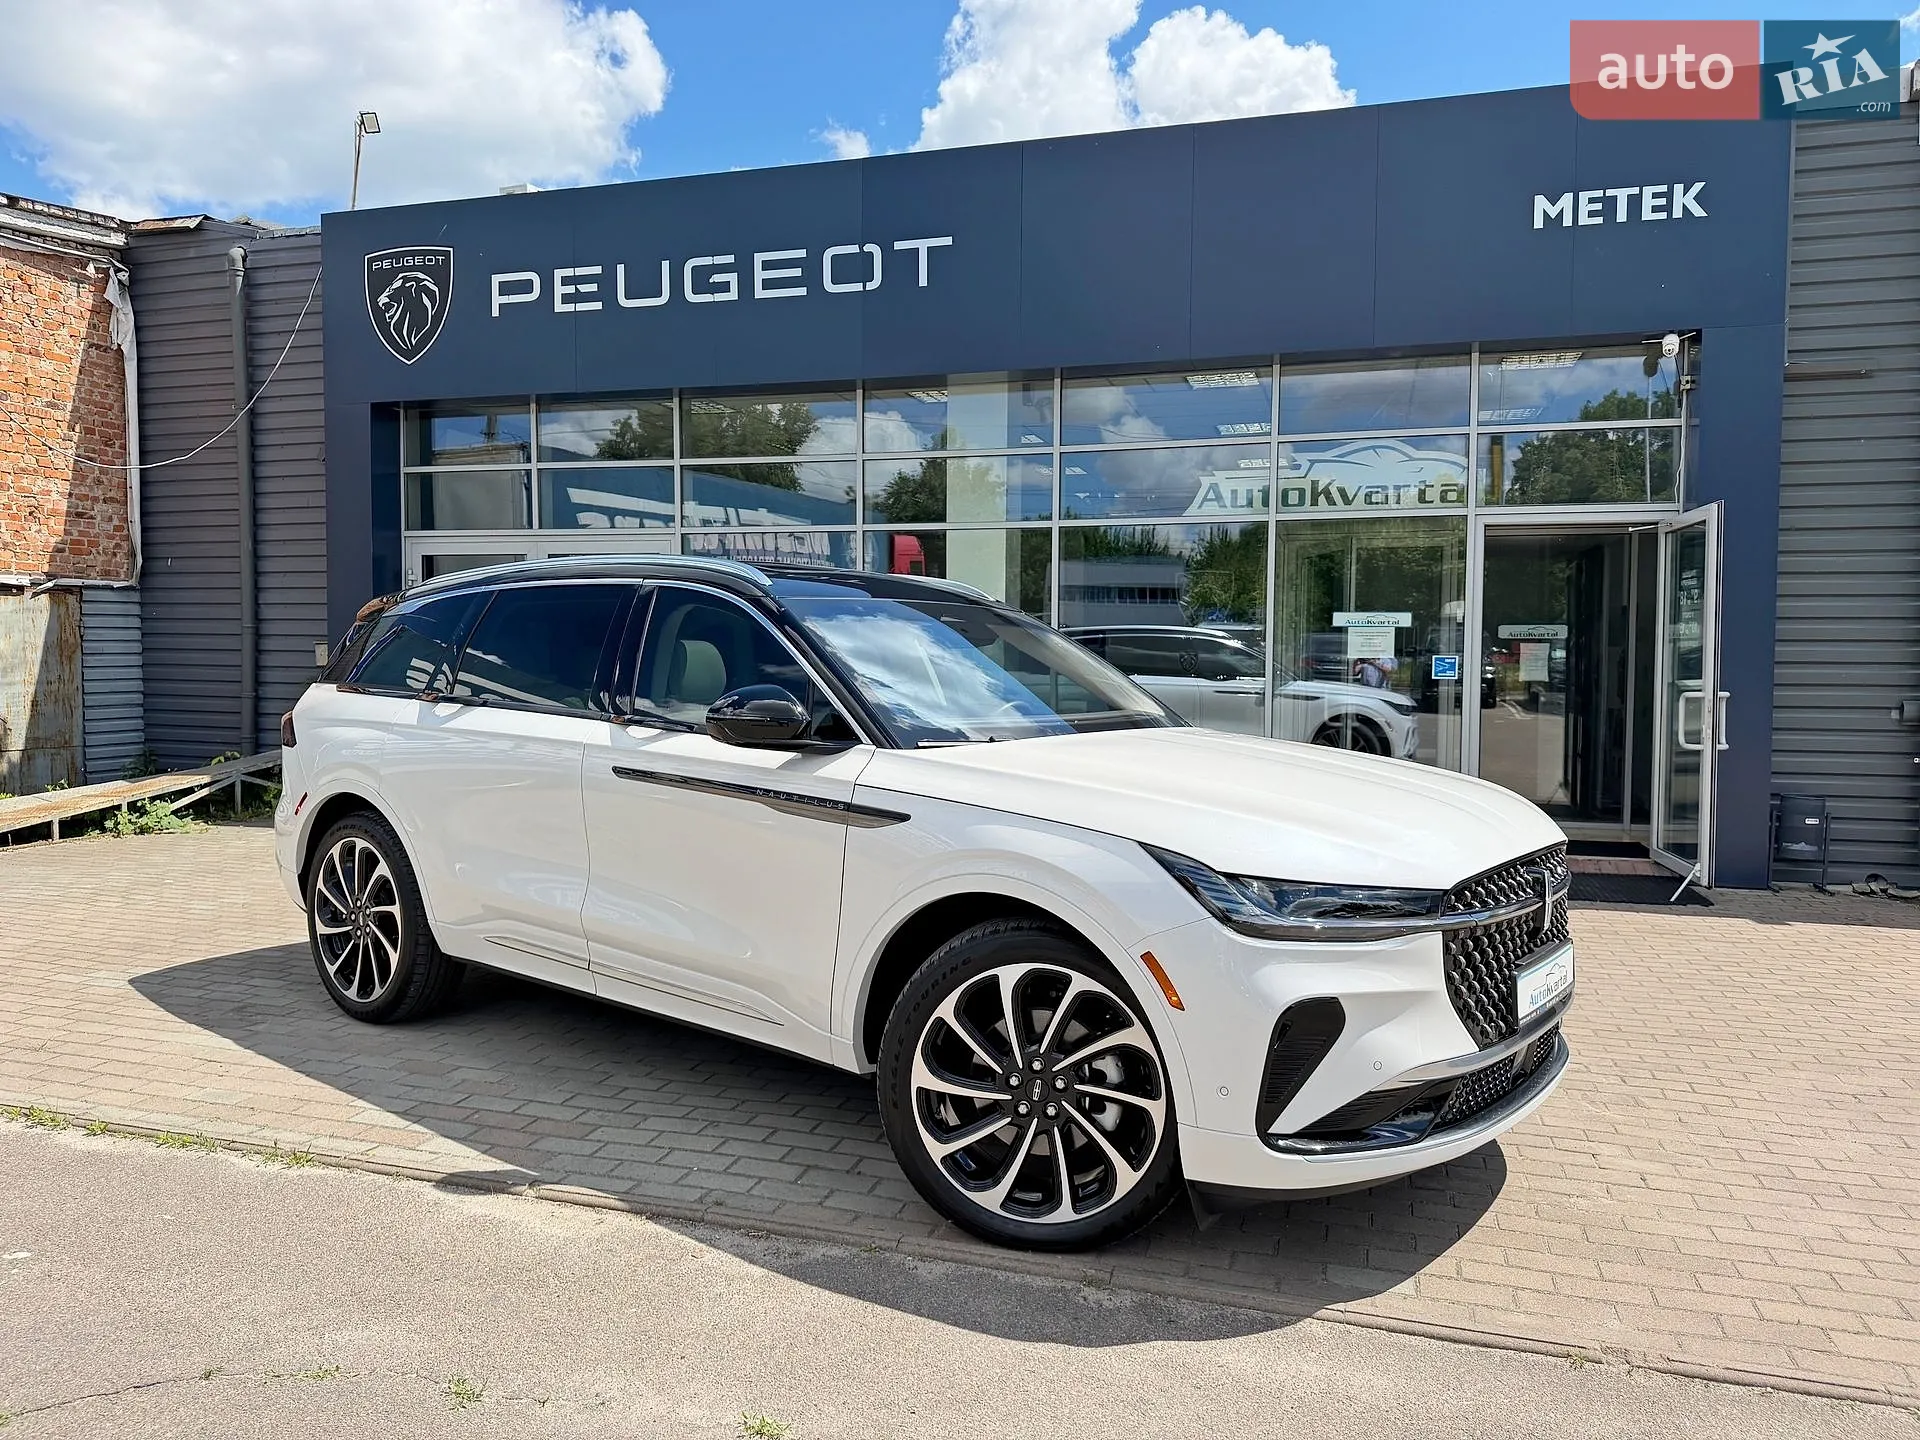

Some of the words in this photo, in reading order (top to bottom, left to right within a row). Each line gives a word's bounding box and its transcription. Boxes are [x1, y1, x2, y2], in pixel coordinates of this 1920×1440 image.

[1533, 181, 1708, 230] METEK
[372, 256, 446, 271] PEUGEOT
[490, 235, 954, 318] PEUGEOT
[1197, 479, 1467, 508] AutoKvarta
[756, 789, 845, 809] NAUTILUS
